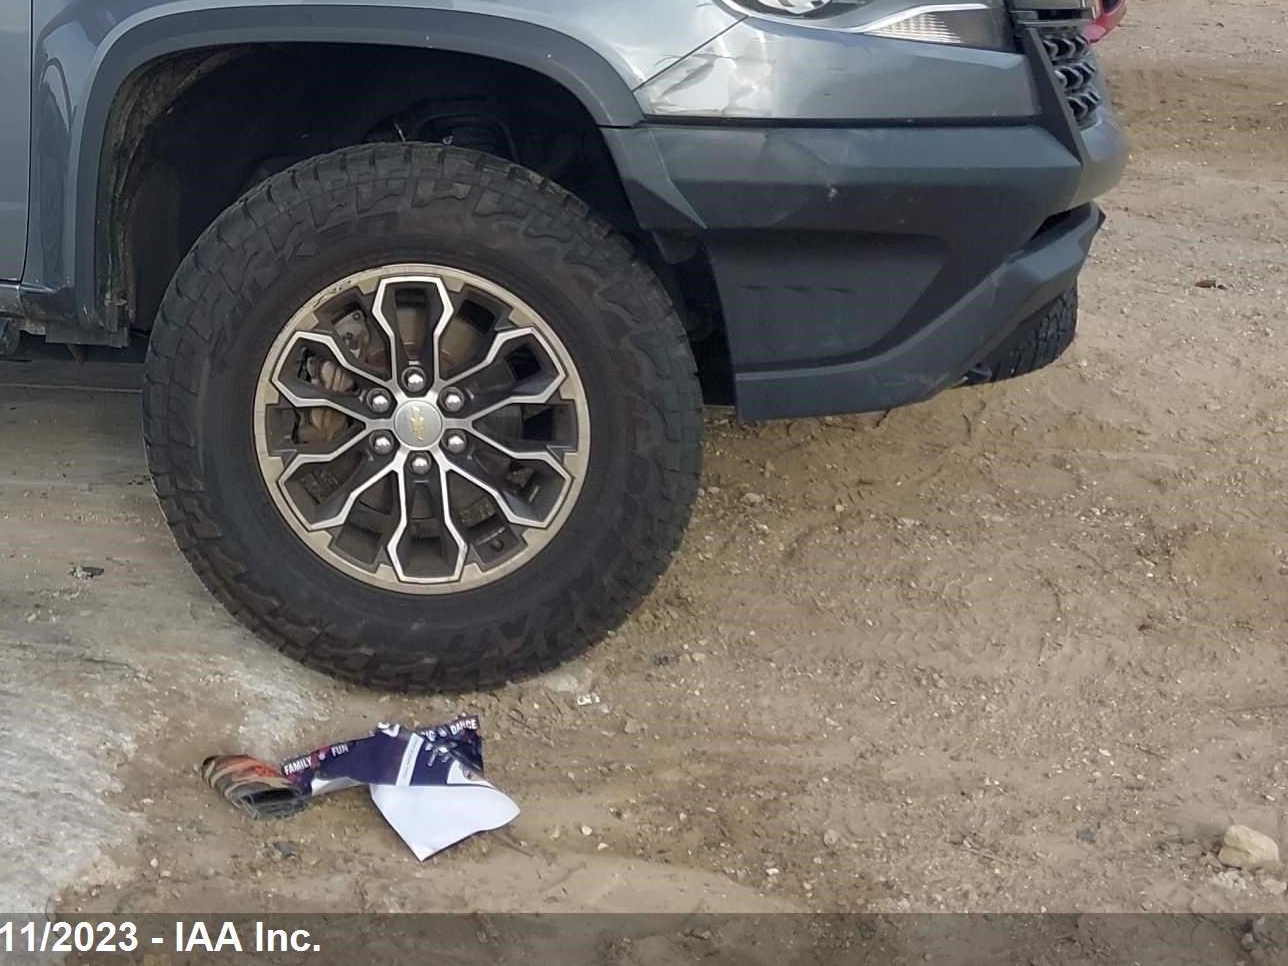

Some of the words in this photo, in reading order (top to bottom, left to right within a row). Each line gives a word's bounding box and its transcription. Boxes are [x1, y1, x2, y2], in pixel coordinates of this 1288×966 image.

[450, 718, 478, 735] DANCE
[283, 755, 313, 776] FAMILY
[330, 743, 349, 757] FUN
